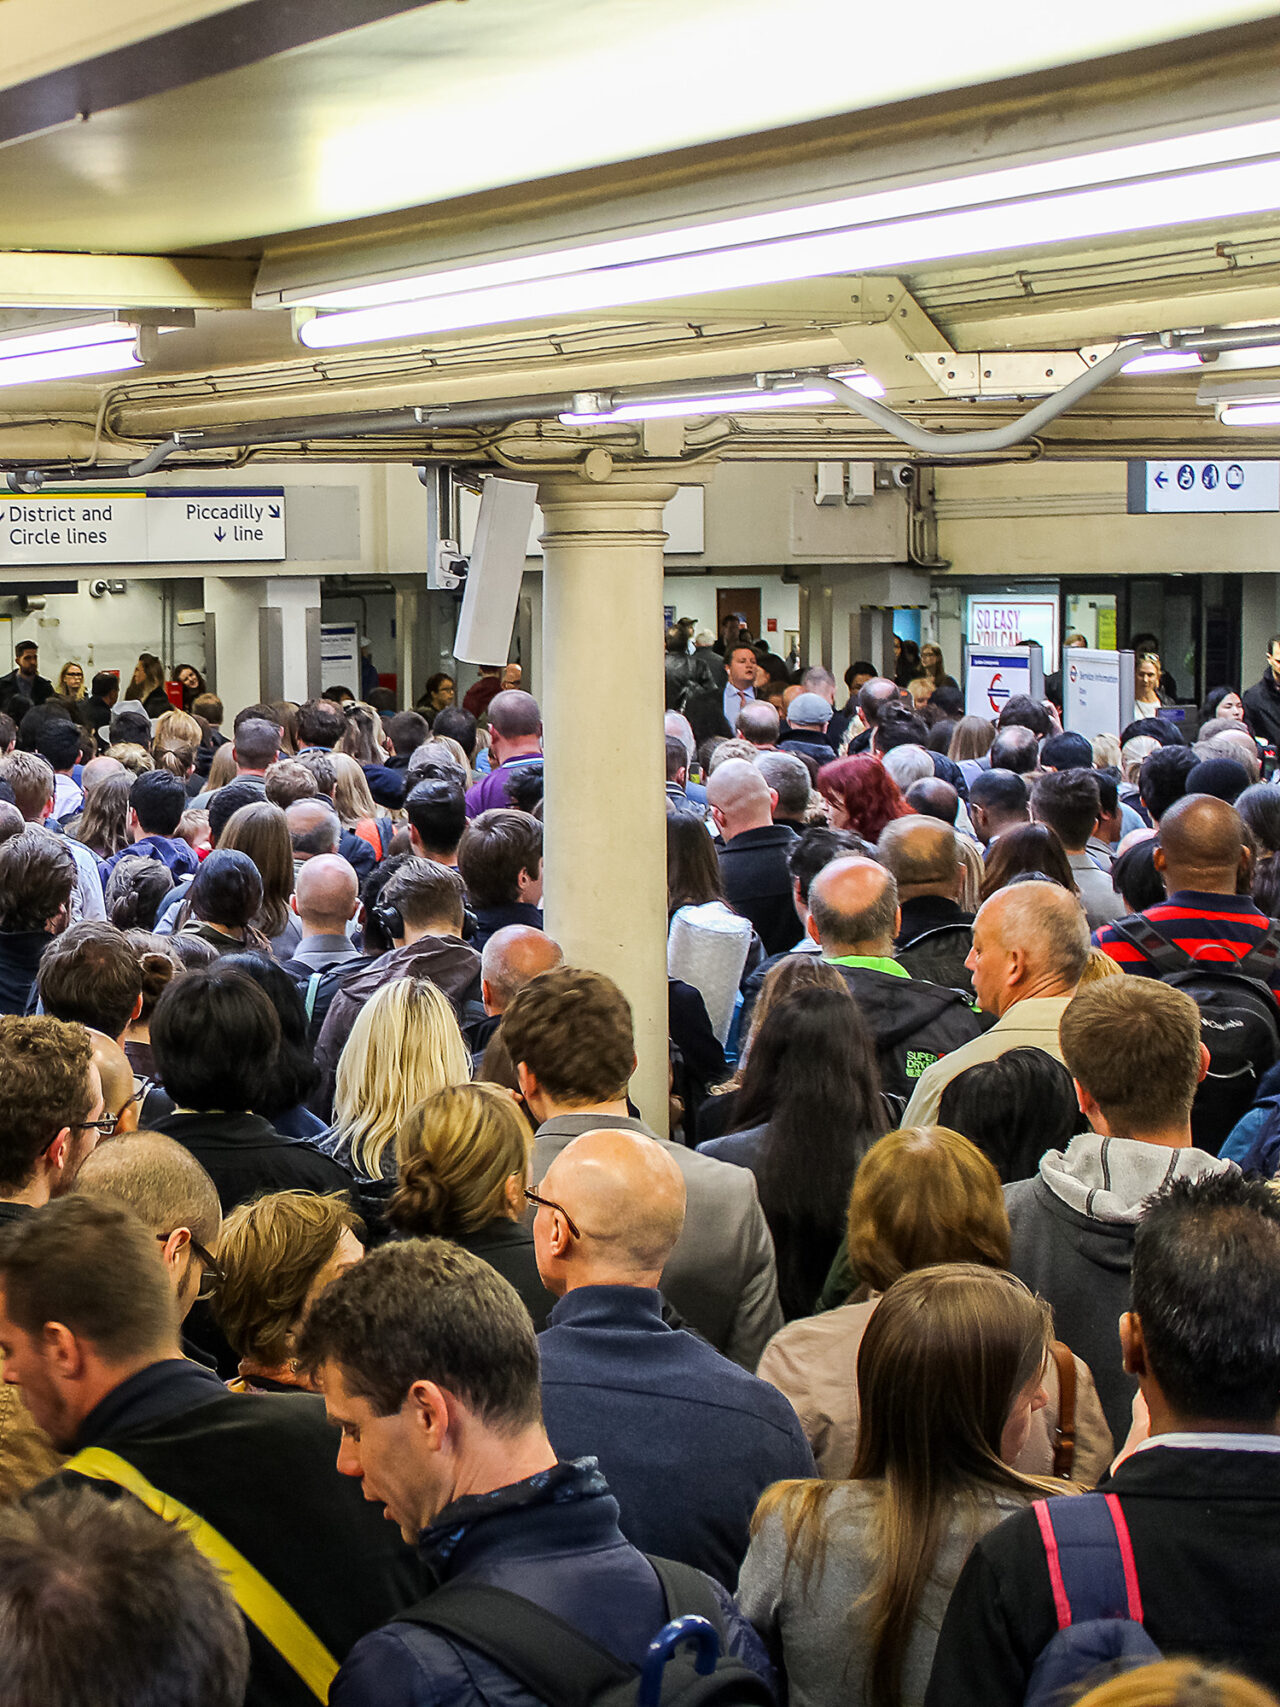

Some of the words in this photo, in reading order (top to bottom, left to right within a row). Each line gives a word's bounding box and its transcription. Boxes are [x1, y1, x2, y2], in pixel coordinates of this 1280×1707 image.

[9, 506, 76, 522] District
[82, 505, 112, 521] and
[186, 504, 263, 522] Piccadilly
[9, 528, 60, 544] Circle
[67, 528, 107, 543] lines
[234, 525, 263, 541] line
[977, 610, 990, 629] SO
[994, 610, 1021, 630] EASY
[977, 631, 998, 647] YOU
[1001, 631, 1022, 647] CAN
[907, 1051, 938, 1062] SUPER
